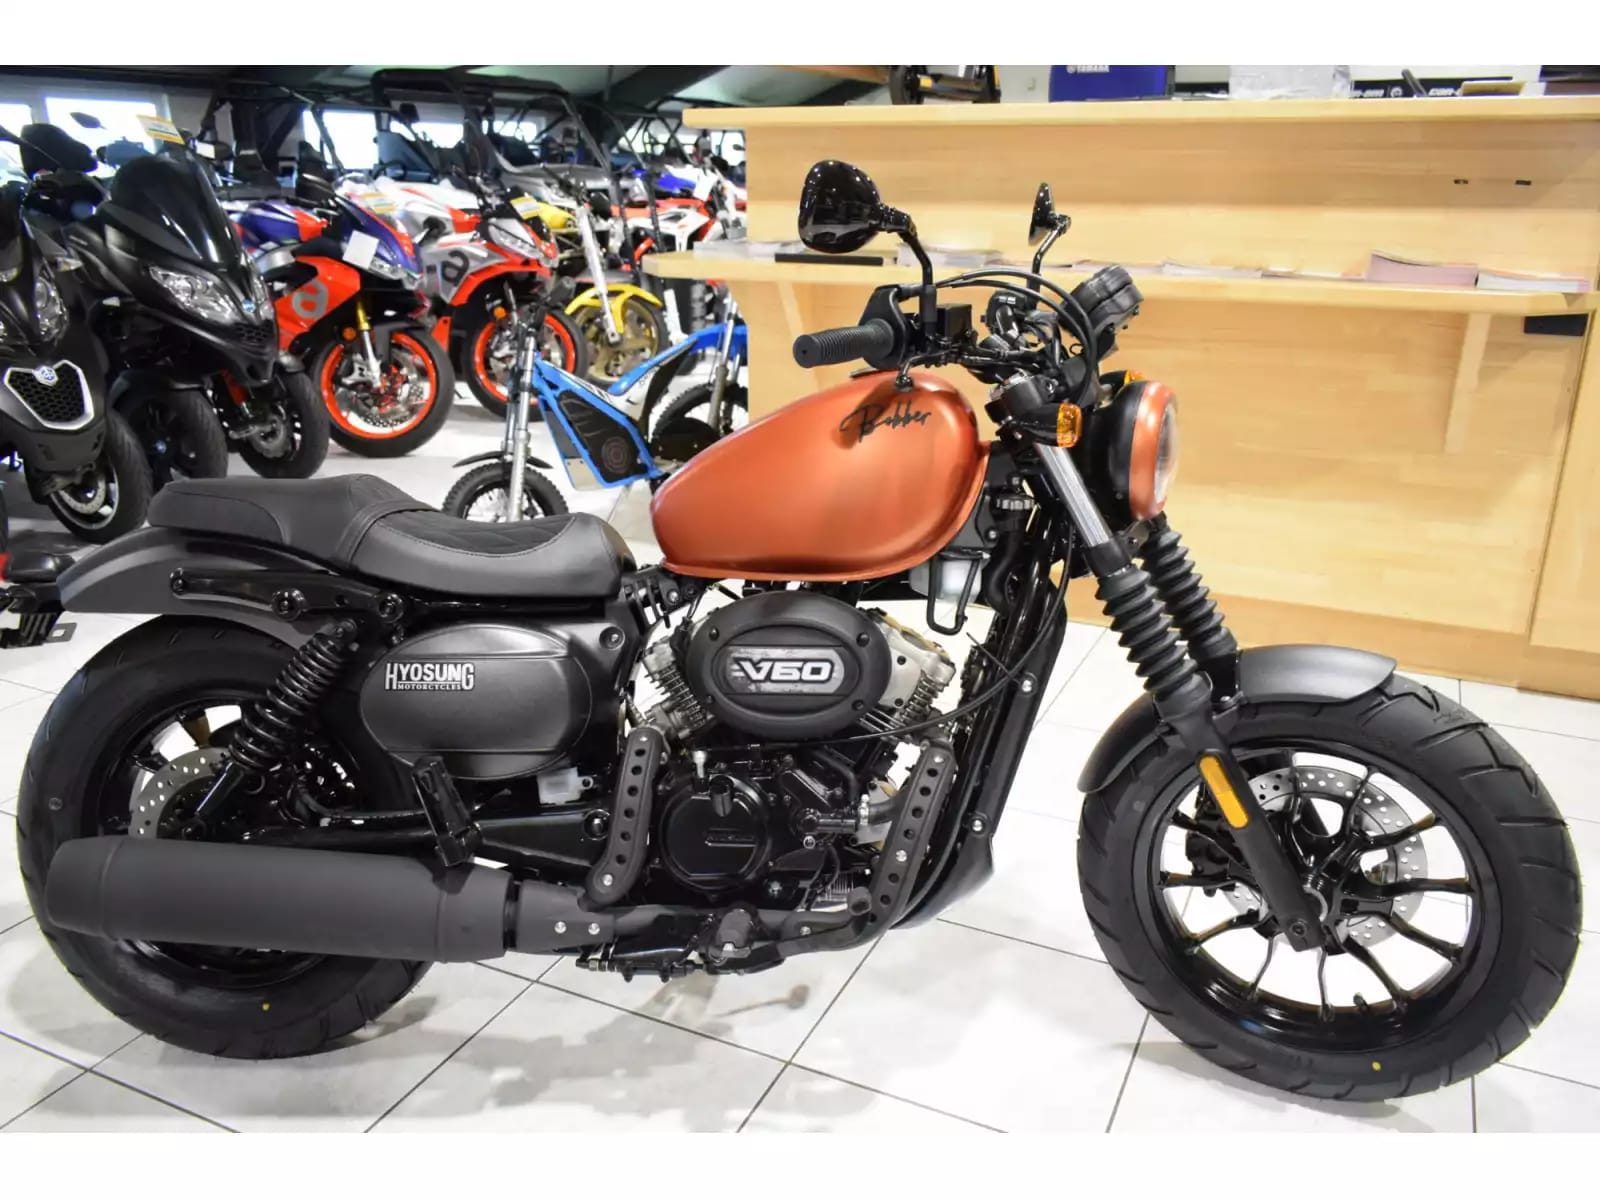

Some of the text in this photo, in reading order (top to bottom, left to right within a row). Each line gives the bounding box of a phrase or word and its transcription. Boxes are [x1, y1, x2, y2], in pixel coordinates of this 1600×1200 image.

[839, 399, 932, 442] Bobber
[385, 662, 474, 690] HYOSUNG
[738, 661, 830, 681] V60
